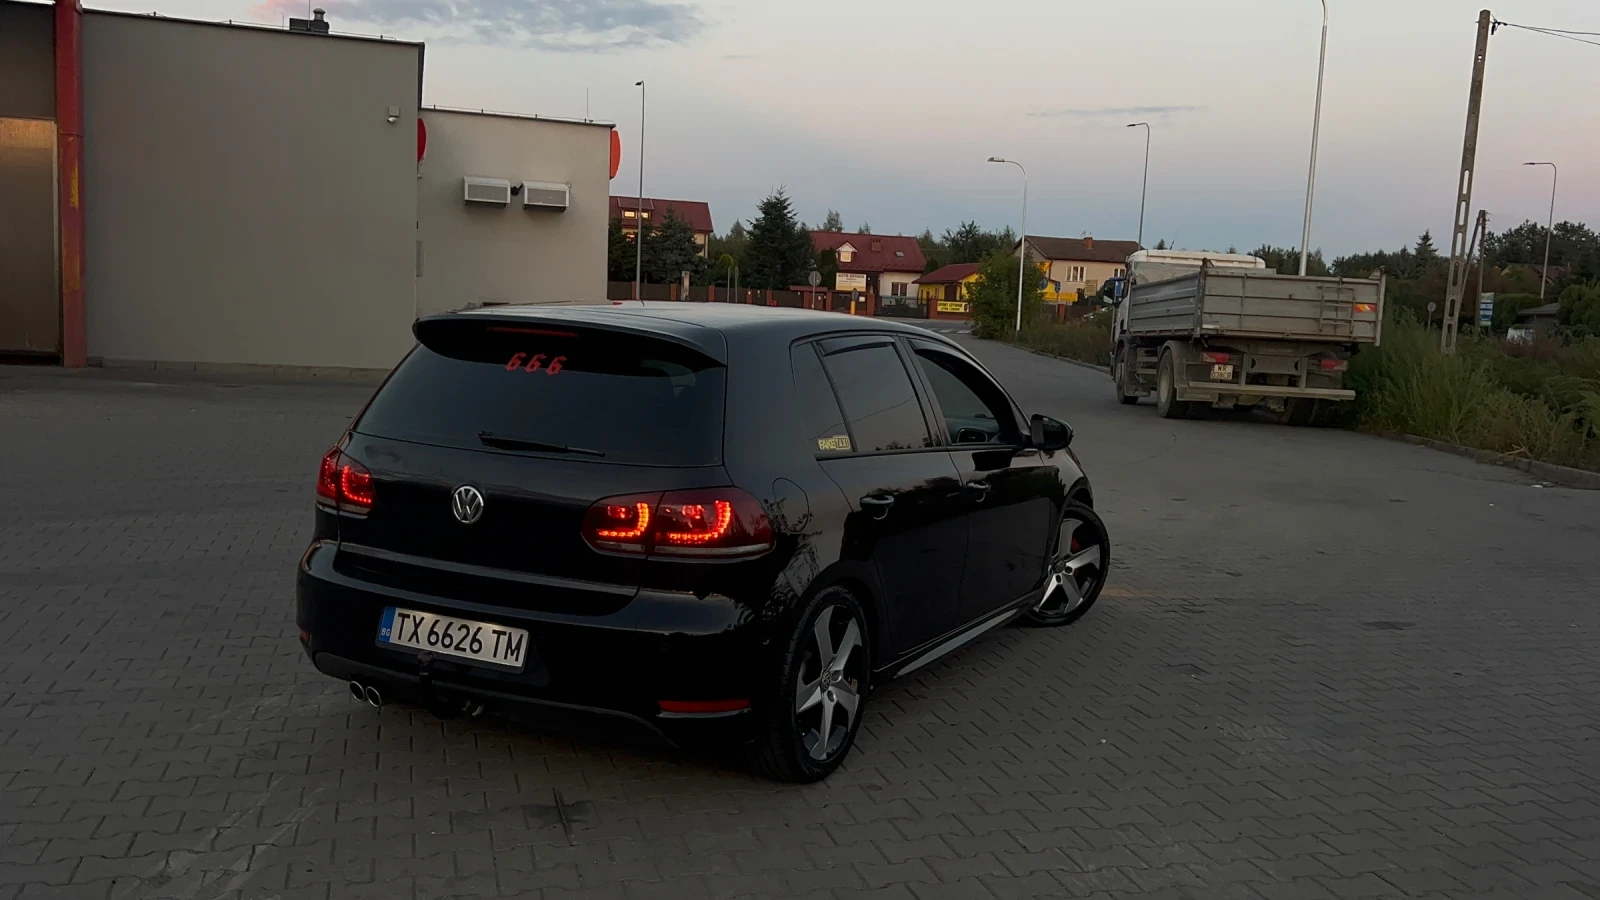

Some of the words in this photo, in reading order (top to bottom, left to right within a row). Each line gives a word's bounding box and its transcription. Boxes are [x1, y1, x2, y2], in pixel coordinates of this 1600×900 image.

[505, 352, 567, 375] 666
[398, 612, 425, 645] TX
[427, 619, 483, 654] 6626
[491, 629, 524, 662] TM
